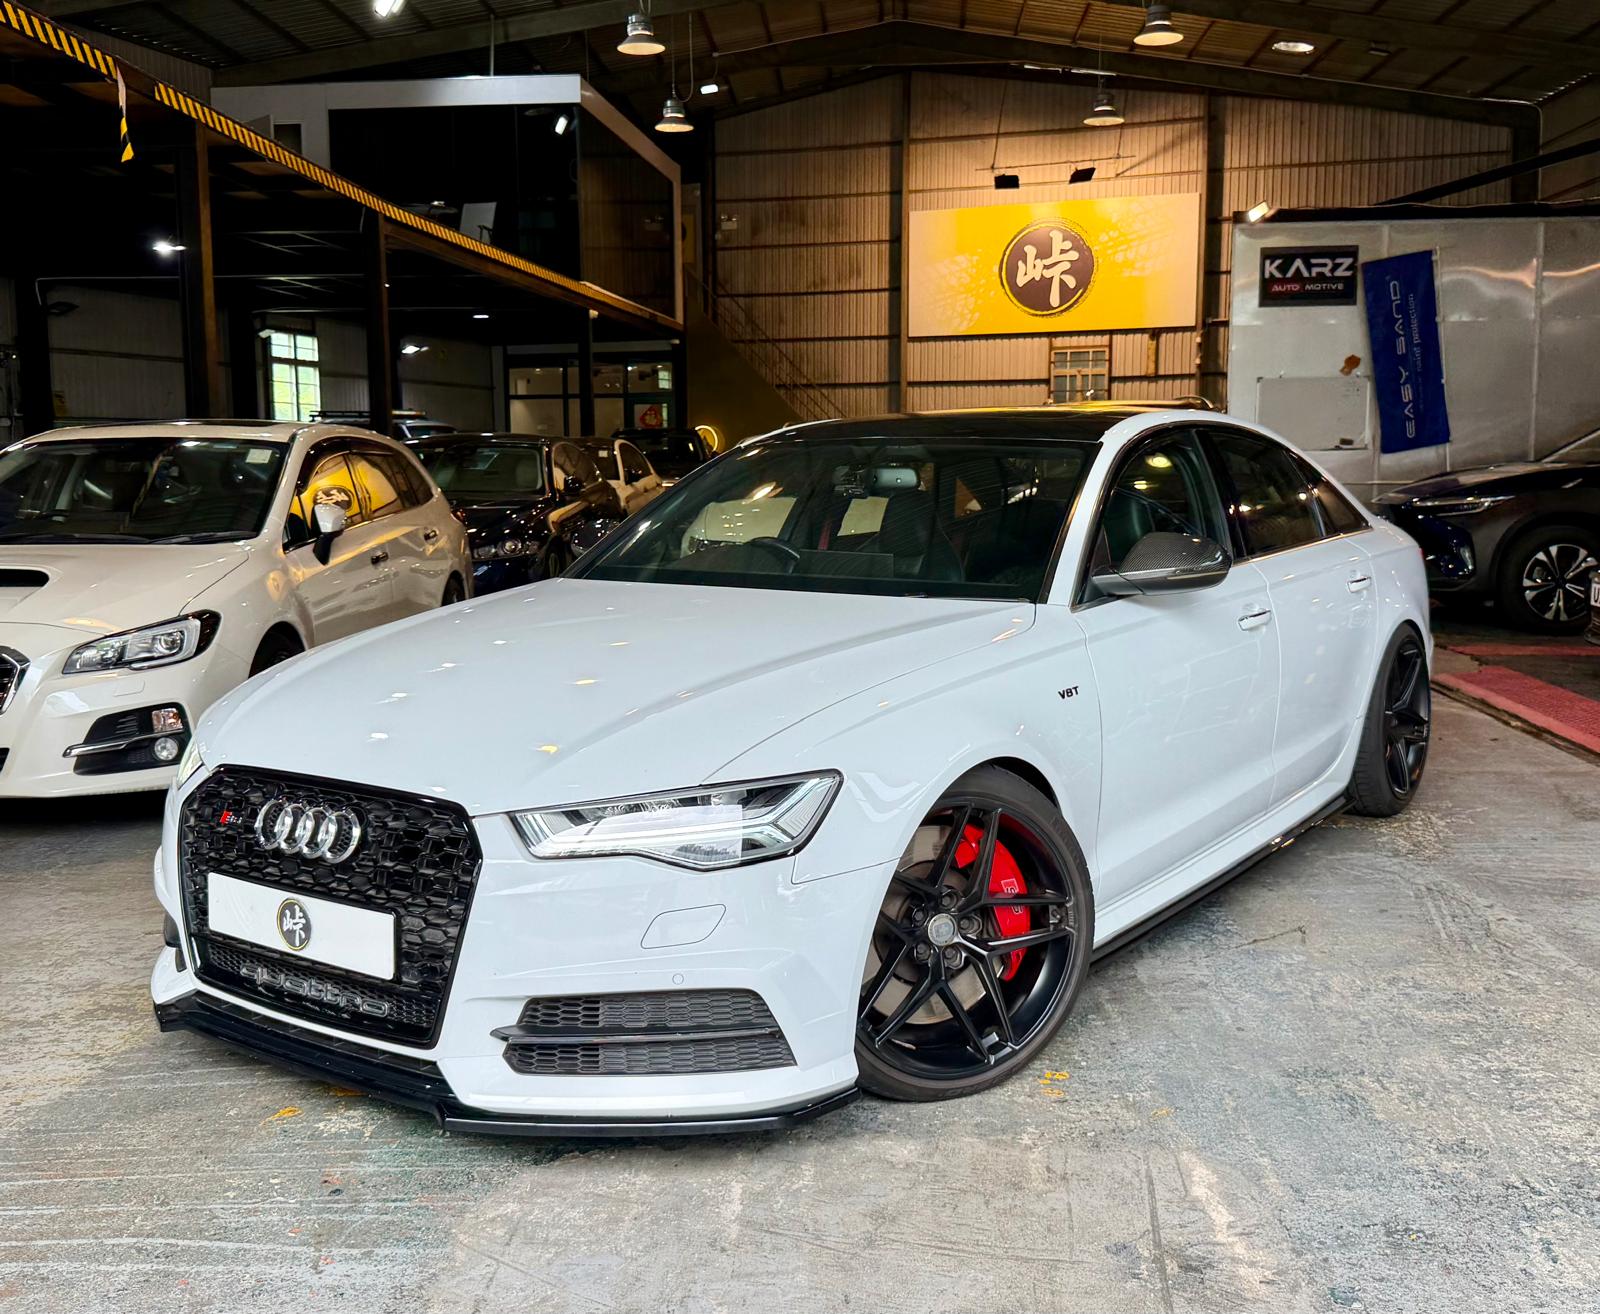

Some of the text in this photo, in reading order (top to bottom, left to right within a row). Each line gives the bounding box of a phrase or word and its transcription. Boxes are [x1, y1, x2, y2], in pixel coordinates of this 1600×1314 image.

[1016, 229, 1080, 308] 峠
[1263, 257, 1354, 279] KARZ
[1271, 282, 1345, 292] AUTO MOTIVE
[1389, 280, 1416, 439] EASY SAND
[283, 904, 306, 947] 峠
[239, 962, 389, 1018] quattro
